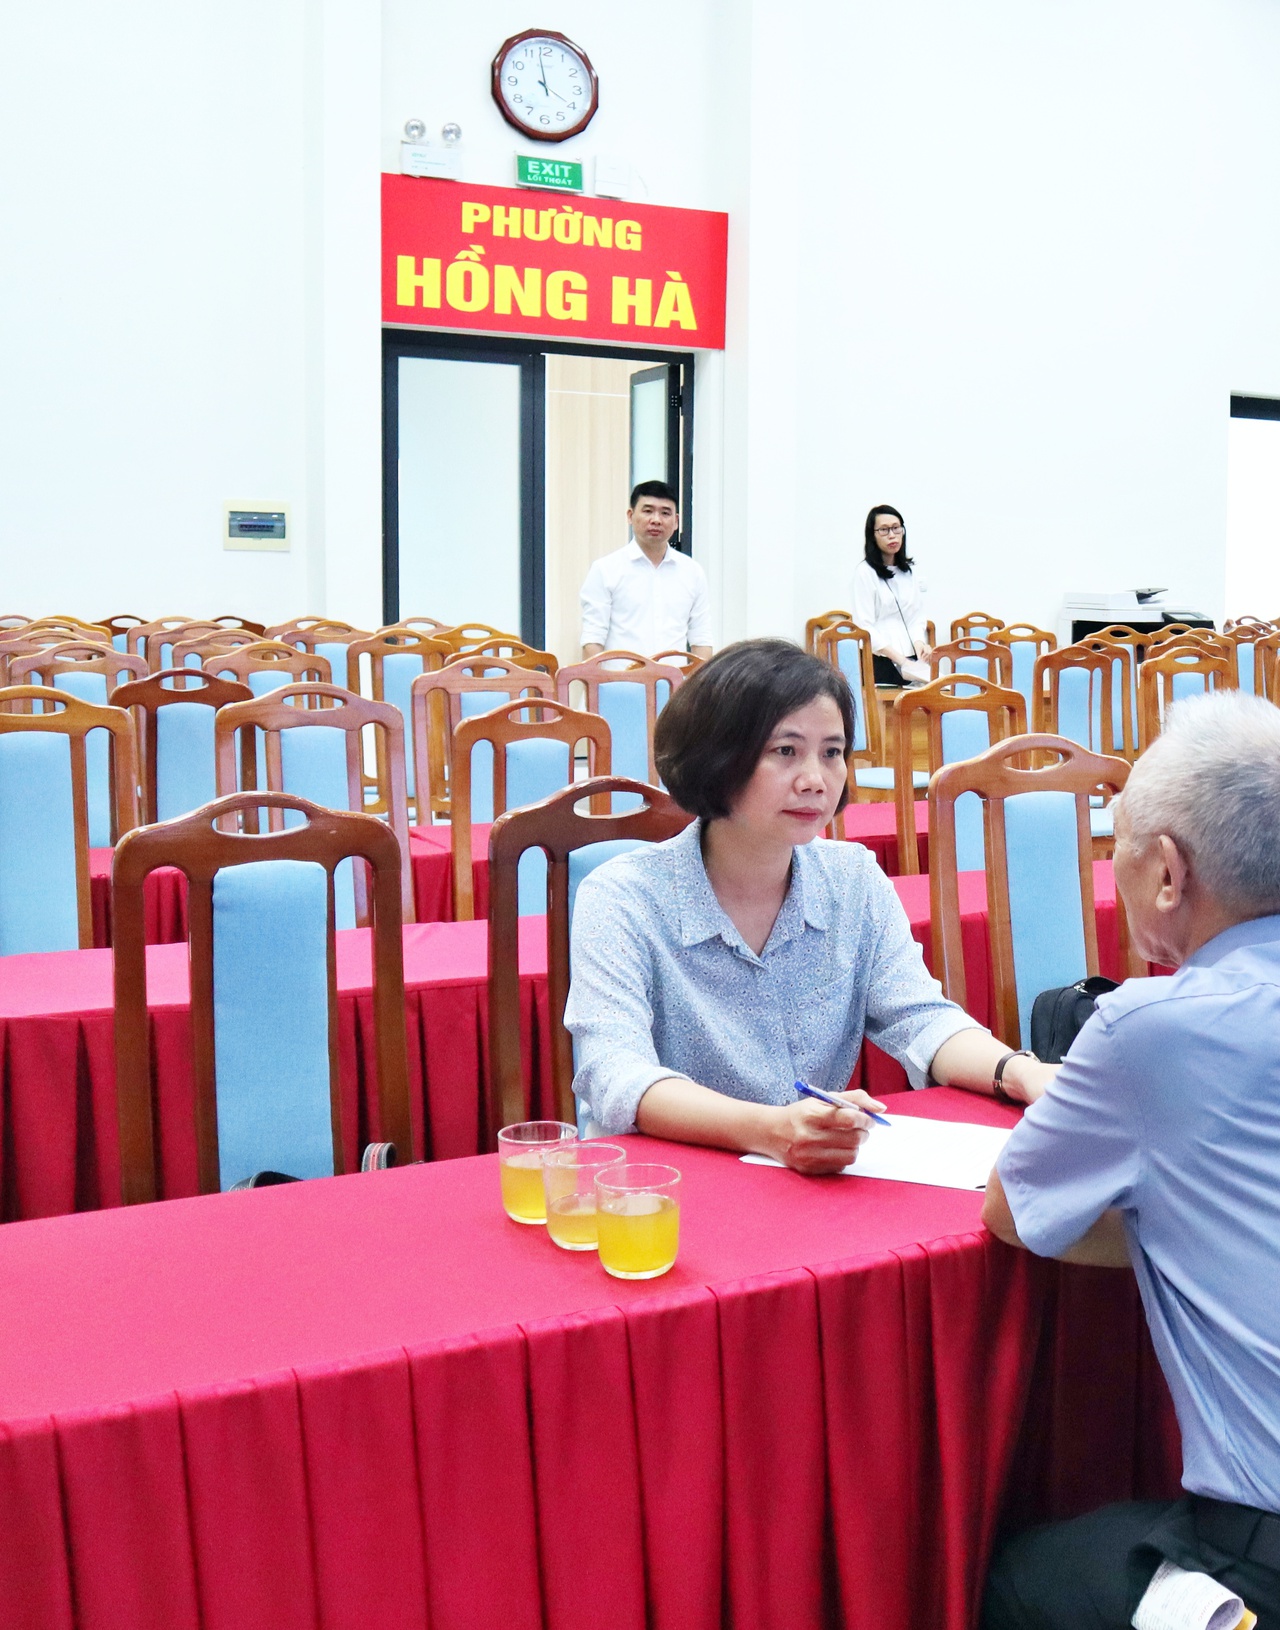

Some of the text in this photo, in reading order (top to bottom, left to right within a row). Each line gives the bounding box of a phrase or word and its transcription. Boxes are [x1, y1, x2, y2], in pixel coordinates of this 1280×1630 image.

[524, 48, 534, 58] 11
[512, 60, 525, 71] 10
[569, 68, 578, 78] 2
[507, 75, 518, 86] 9
[572, 85, 582, 96] 3
[513, 94, 523, 103] 8
[525, 106, 534, 115] 7
[566, 101, 577, 110] 4
[539, 115, 550, 125] 6
[556, 111, 566, 121] 5
[527, 160, 572, 178] EXIT
[461, 201, 642, 251] PHƯỜNG
[396, 244, 698, 330] HỒNG HÀ
